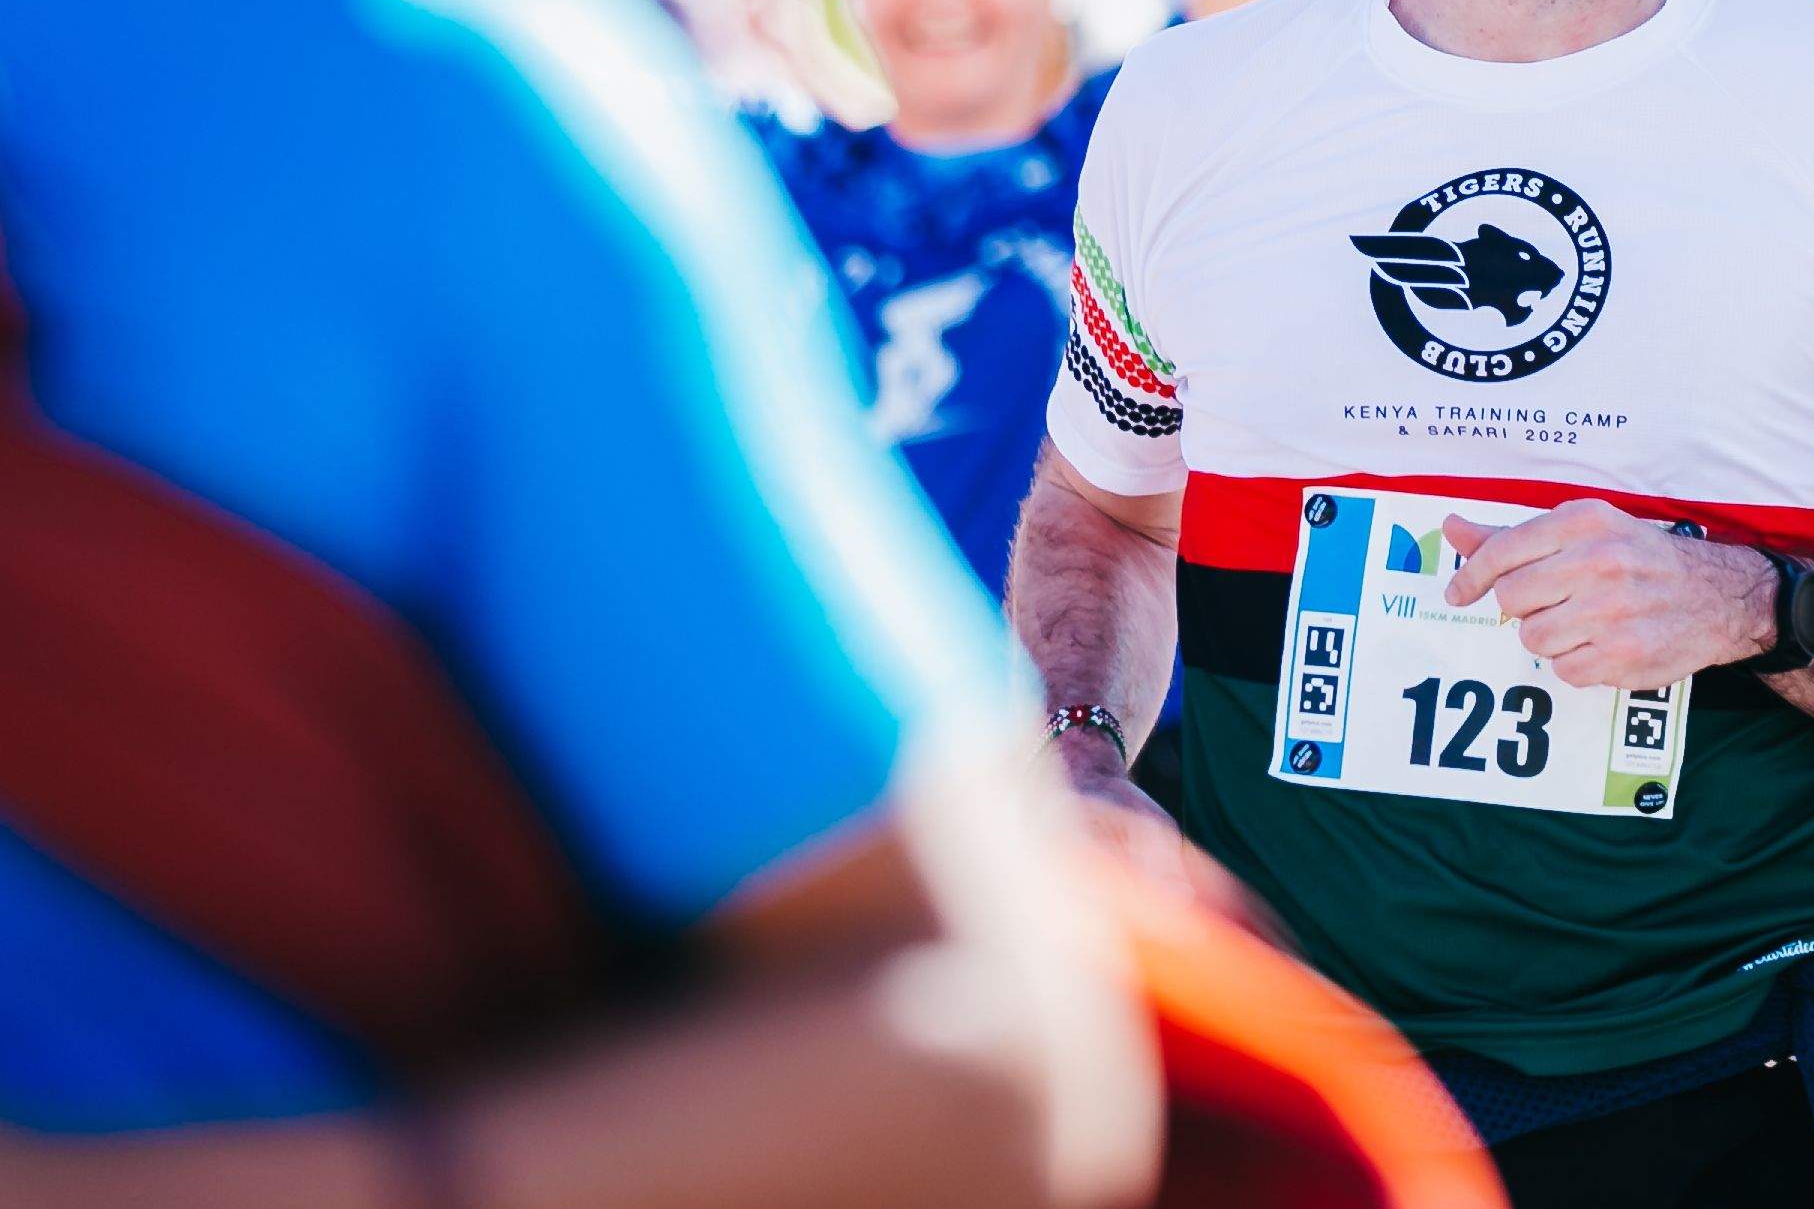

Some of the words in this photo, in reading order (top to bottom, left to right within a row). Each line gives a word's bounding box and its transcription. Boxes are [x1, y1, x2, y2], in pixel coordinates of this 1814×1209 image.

[1420, 173, 1544, 213] TIGERS
[1543, 205, 1606, 353] RUNNING
[1421, 340, 1513, 377] CLUB
[1343, 404, 1418, 420] KENYA
[1435, 405, 1546, 424] TRAINING
[1565, 411, 1628, 429] CAMP
[1398, 425, 1409, 436] &
[1427, 425, 1507, 439] SAFARI
[1525, 428, 1577, 445] 2022
[1382, 594, 1417, 619] VIII
[1451, 613, 1498, 627] MADRID
[1402, 677, 1554, 780] 123
